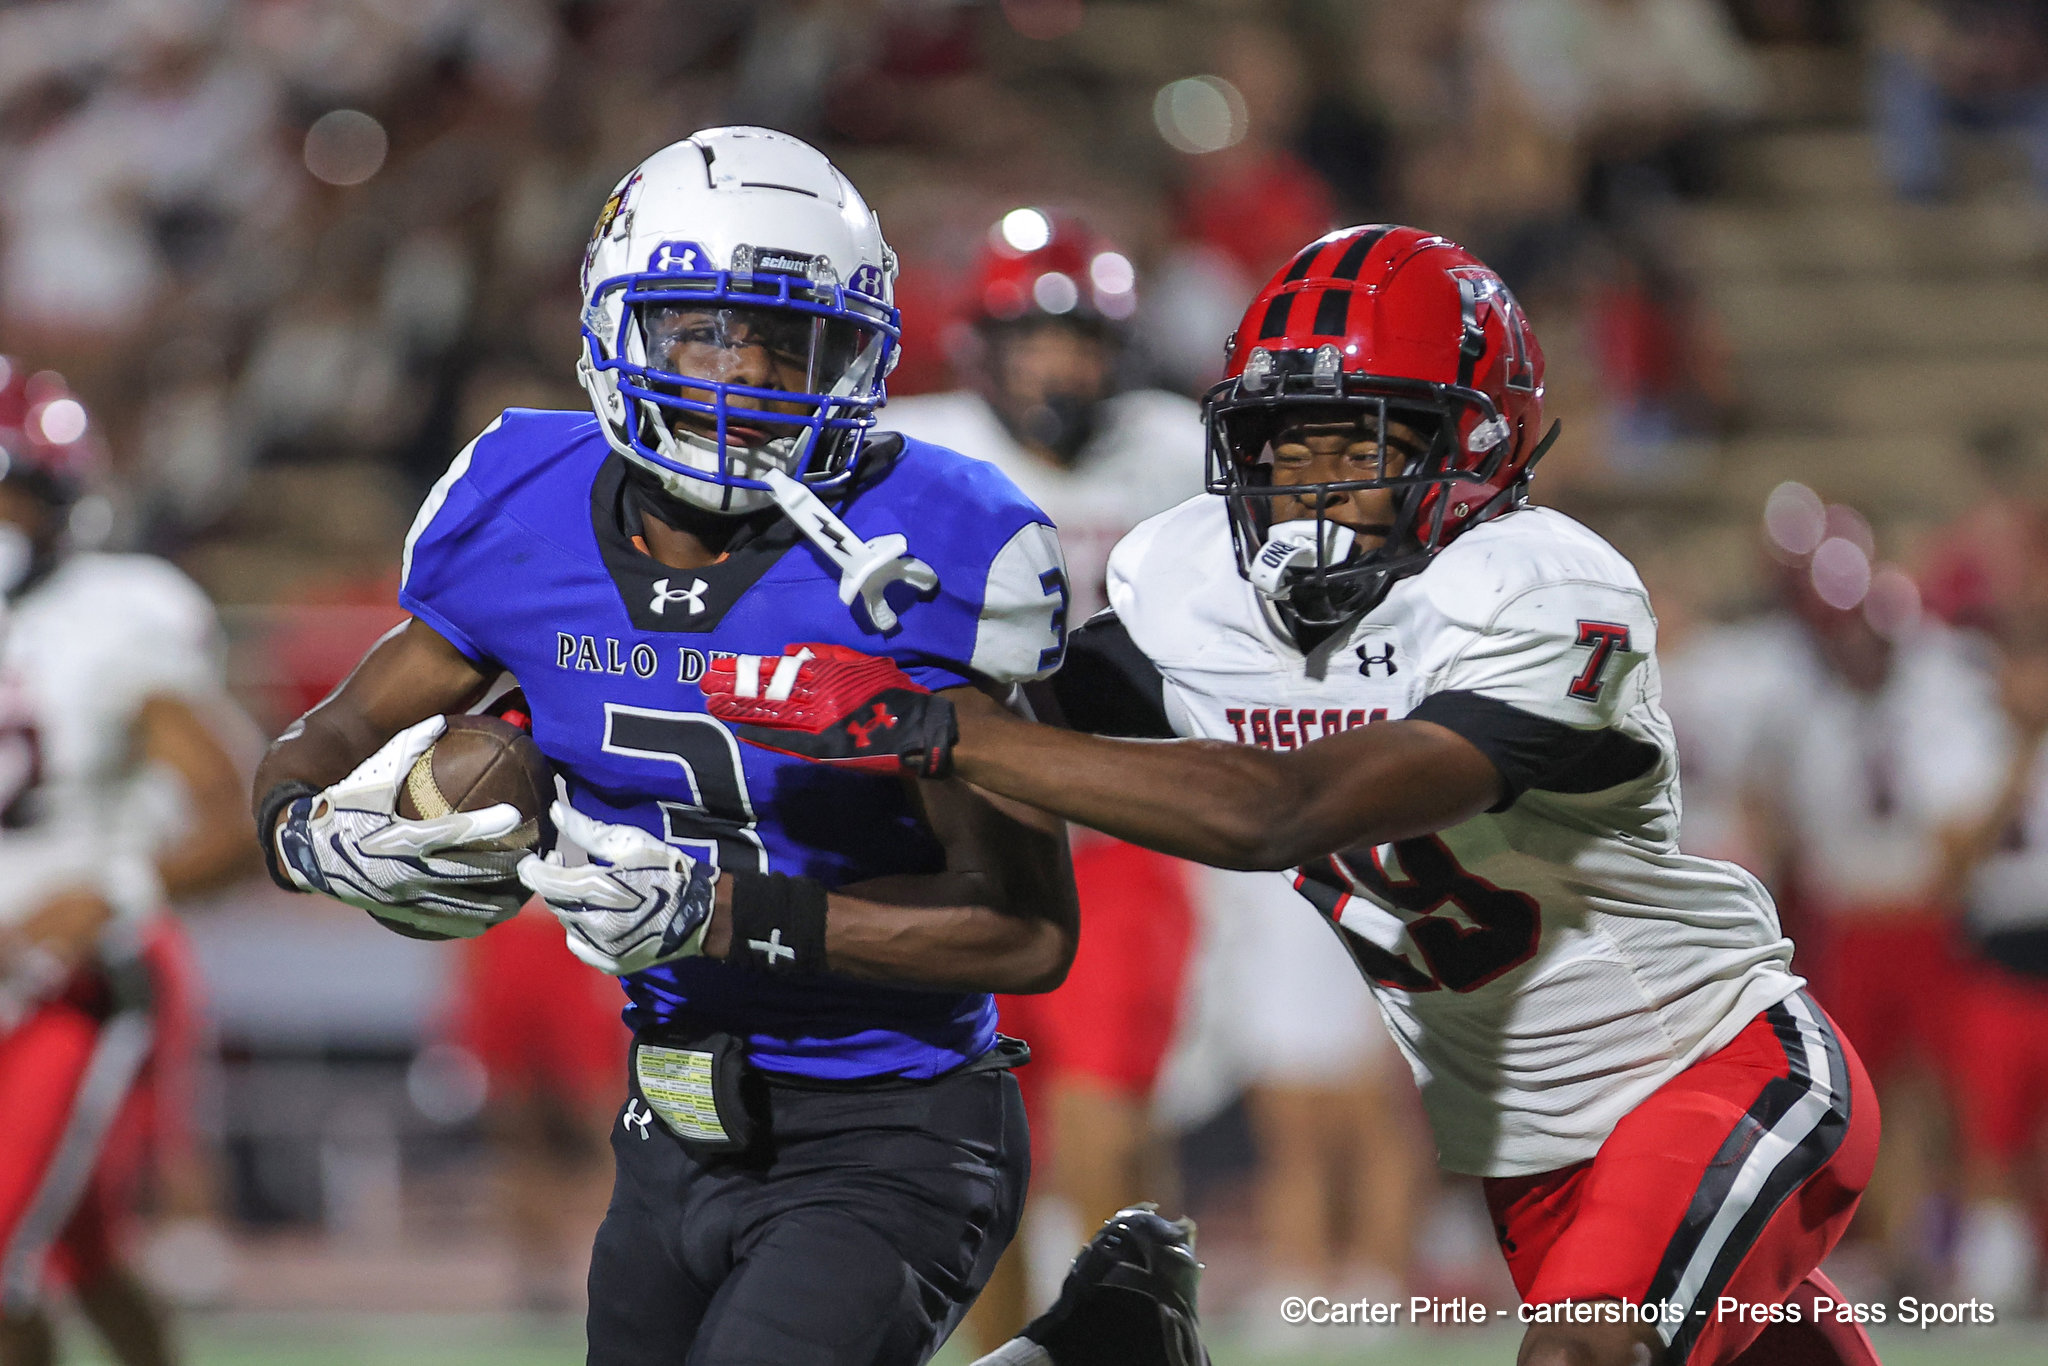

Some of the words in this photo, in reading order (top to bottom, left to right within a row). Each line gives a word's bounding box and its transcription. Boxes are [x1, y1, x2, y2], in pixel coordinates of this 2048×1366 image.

[556, 631, 658, 679] PALO
[1566, 619, 1632, 703] T
[1225, 707, 1388, 751] TASC
[601, 702, 769, 876] 3
